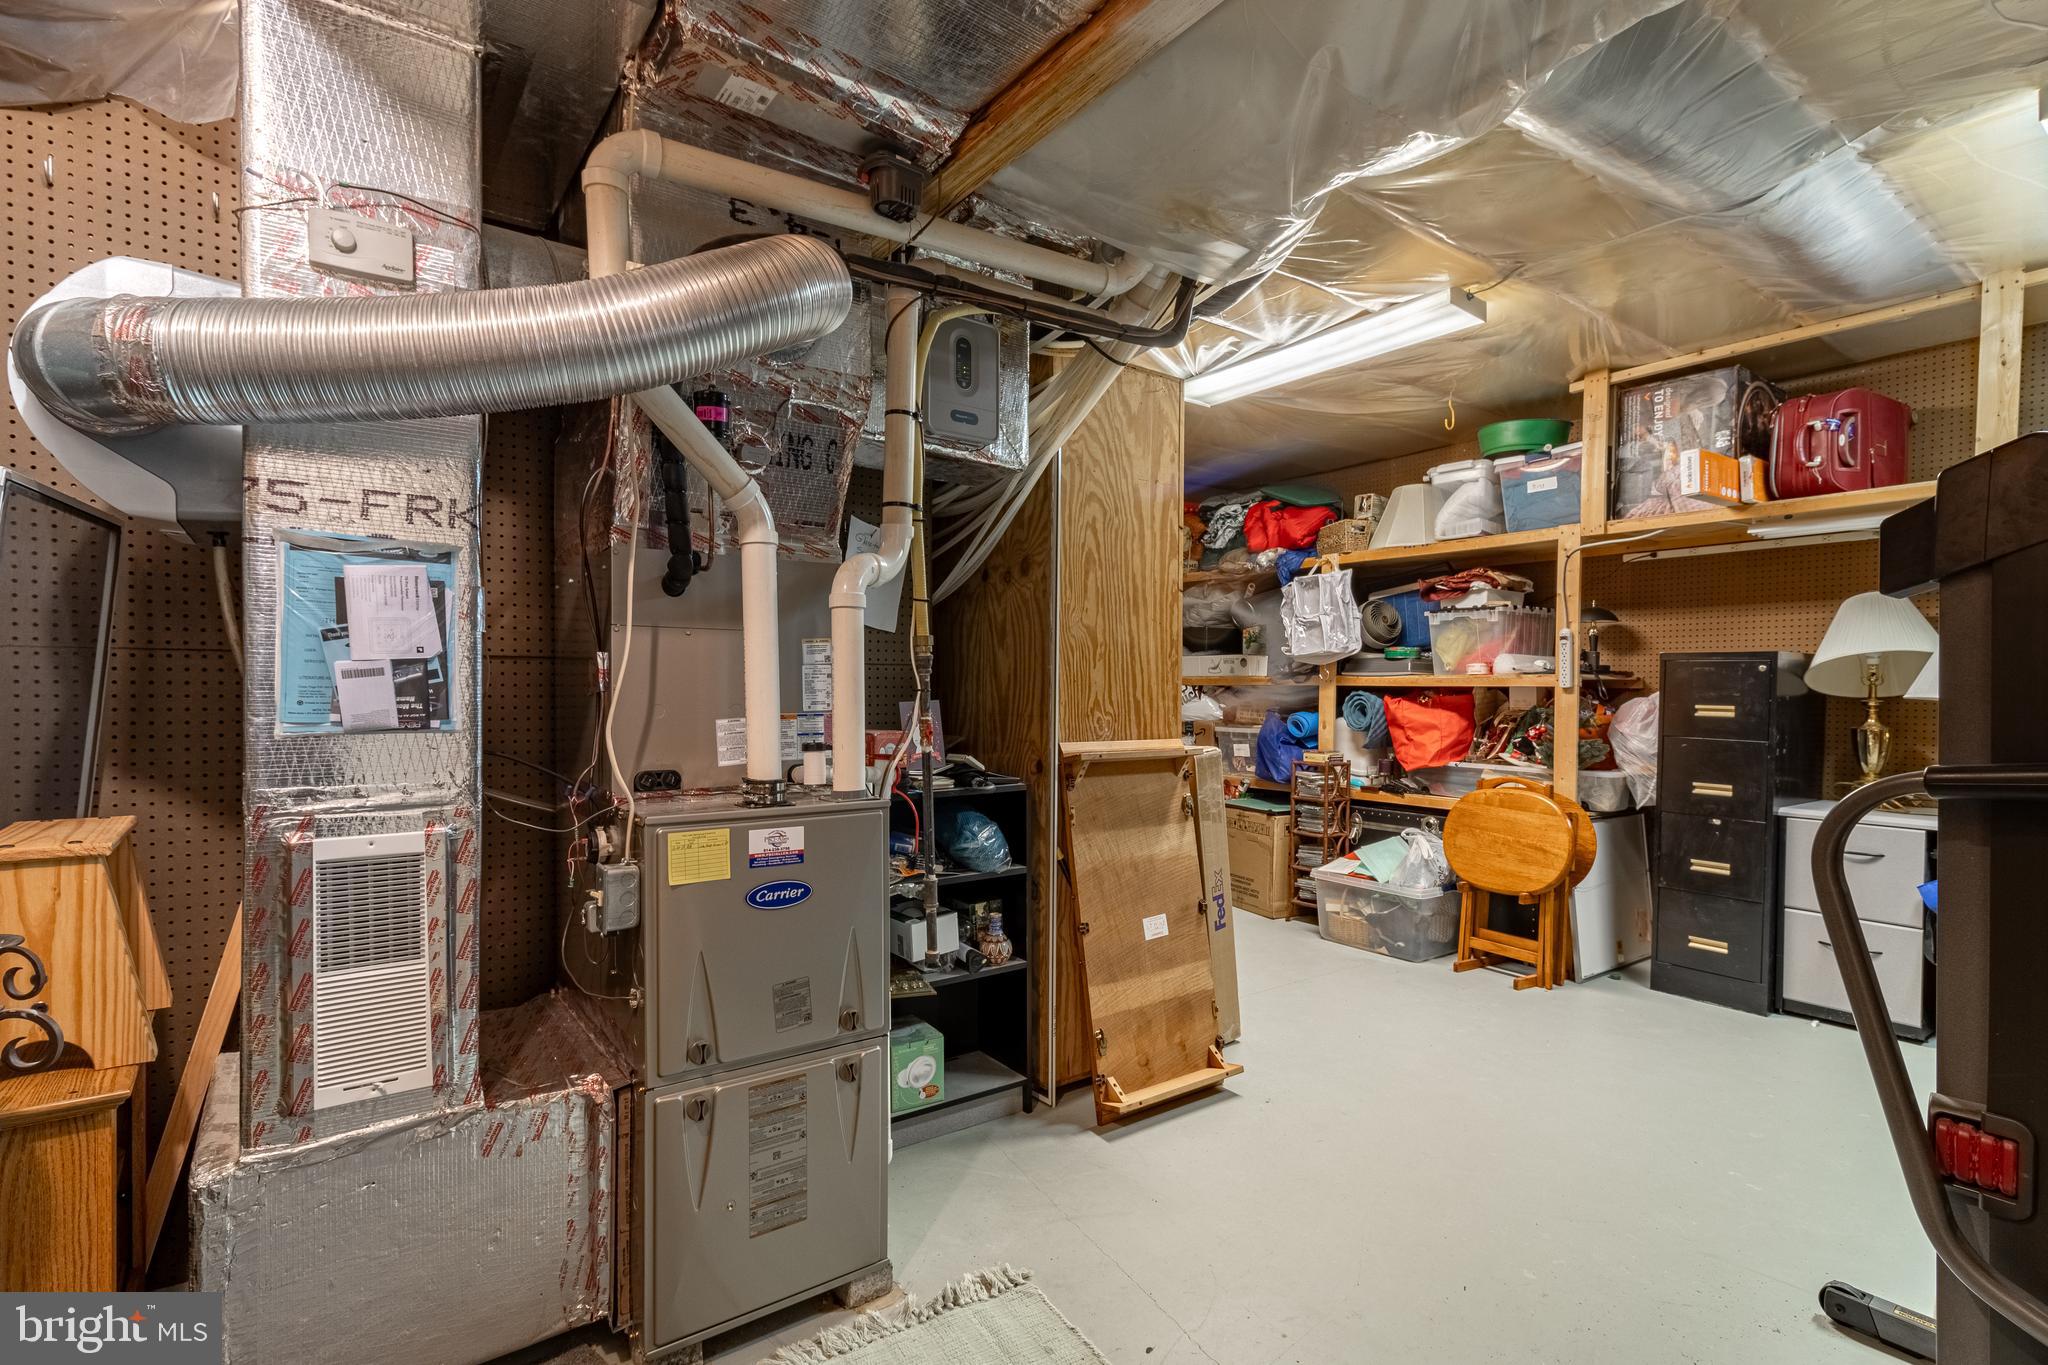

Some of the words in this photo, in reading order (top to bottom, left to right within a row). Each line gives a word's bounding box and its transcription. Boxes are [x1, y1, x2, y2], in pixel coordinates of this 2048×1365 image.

[1654, 388, 1665, 403] TO
[1653, 404, 1665, 437] ENJOY
[756, 887, 804, 902] Carrier
[1212, 867, 1226, 932] FedEx
